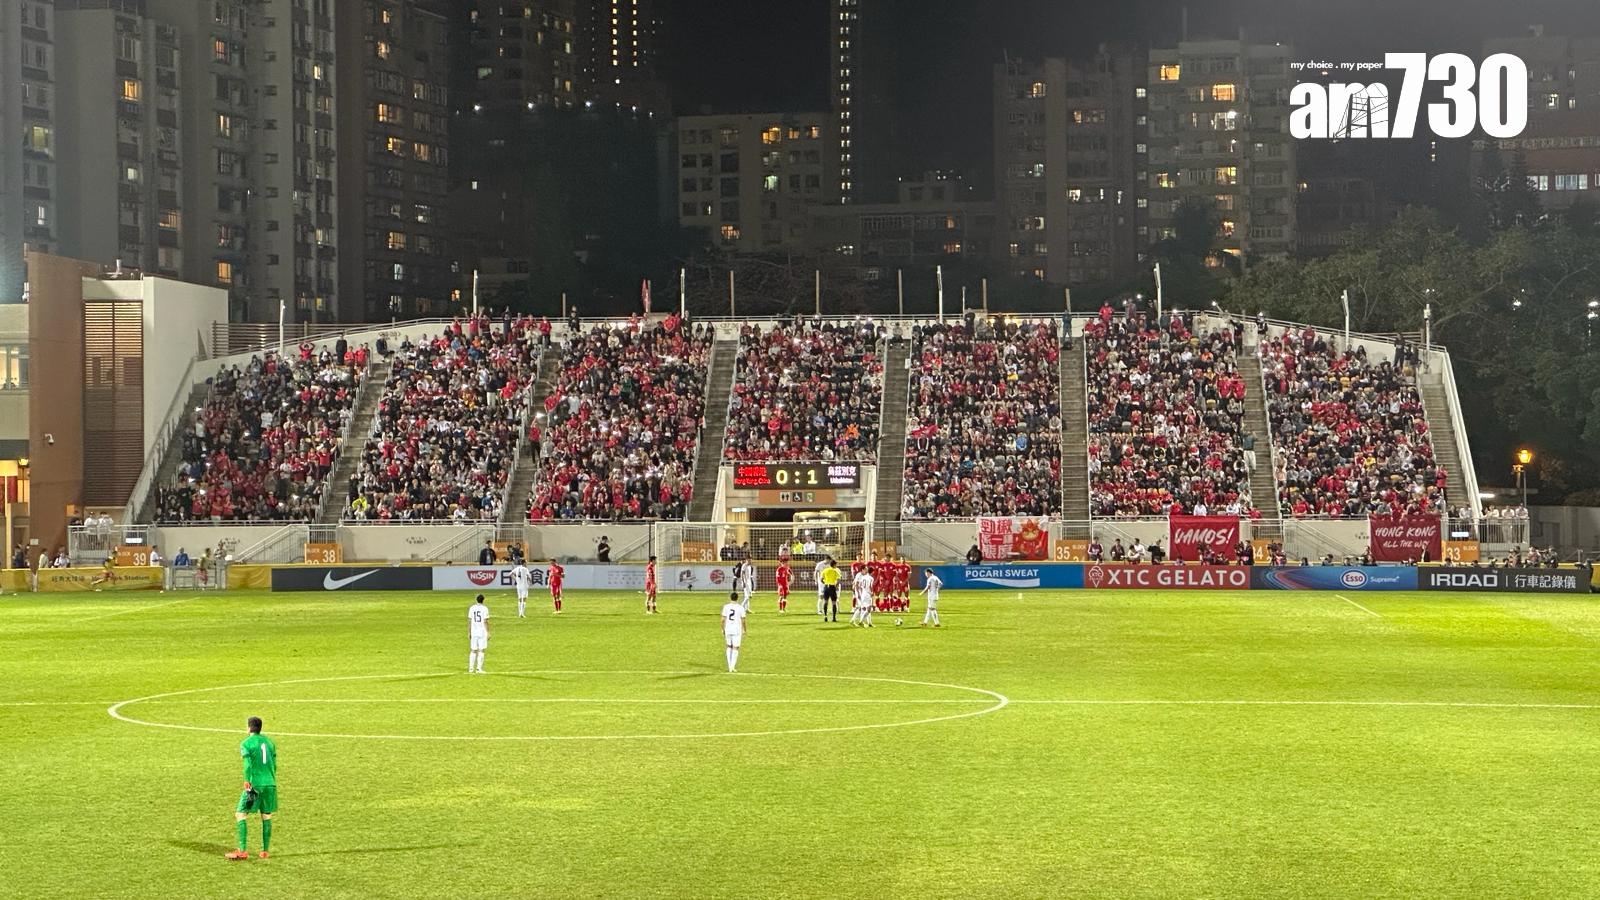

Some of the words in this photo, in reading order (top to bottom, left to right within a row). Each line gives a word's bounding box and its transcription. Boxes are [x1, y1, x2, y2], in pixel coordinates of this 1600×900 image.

[1174, 528, 1235, 545] VAMOS!
[1375, 526, 1404, 538] HONG
[1406, 525, 1437, 538] KONG
[1383, 540, 1399, 548] ALL
[1400, 540, 1414, 548] THE
[133, 552, 147, 566] 39
[322, 549, 336, 563] 38
[700, 549, 713, 561] 36
[1056, 546, 1071, 560] 35
[1446, 547, 1461, 561] 33
[470, 571, 495, 581] NISSIN
[965, 569, 1003, 578] POCARI
[1004, 569, 1040, 577] SWEAT
[1107, 569, 1150, 585] XTC
[1157, 569, 1246, 586] GELATO
[1345, 574, 1364, 583] Esso
[1430, 573, 1499, 587] IROAD
[1514, 574, 1577, 589] 行車記錄儀
[473, 610, 482, 623] 15
[729, 609, 735, 621] 2
[260, 742, 267, 765] 1
